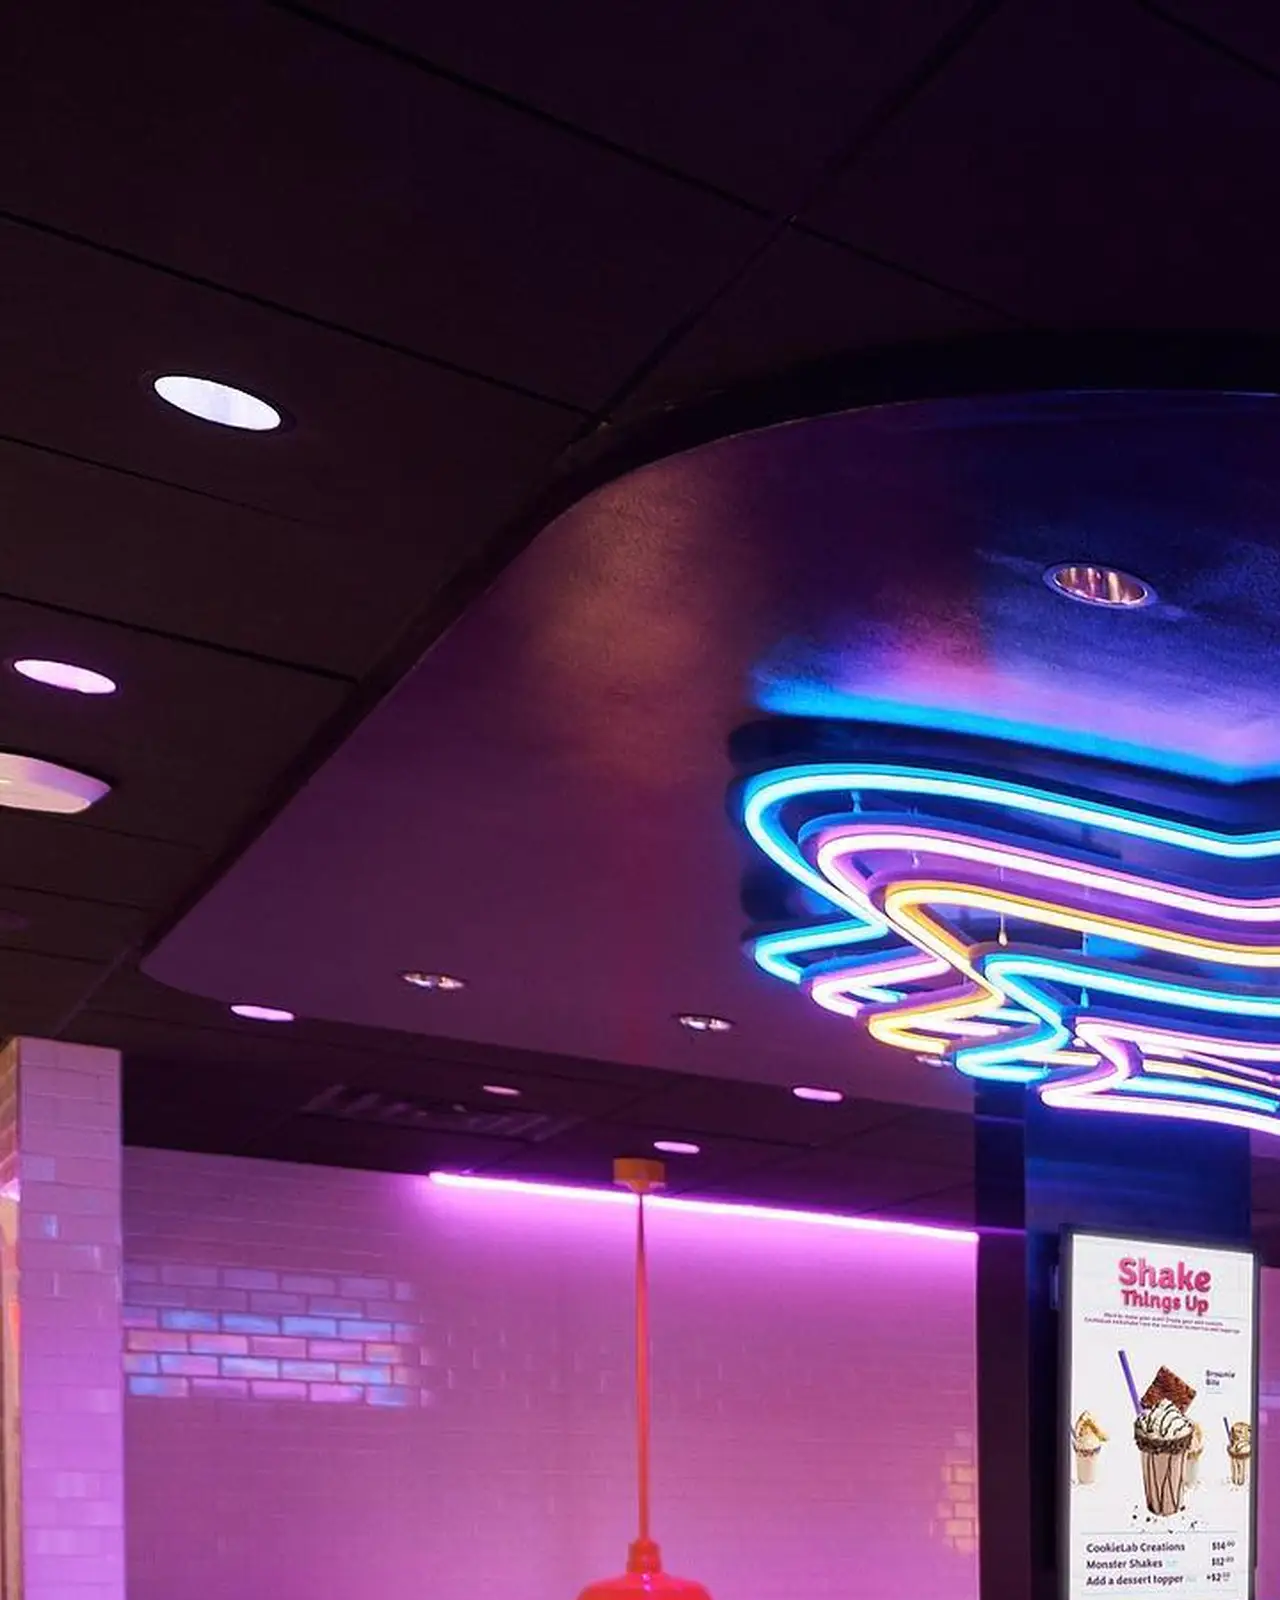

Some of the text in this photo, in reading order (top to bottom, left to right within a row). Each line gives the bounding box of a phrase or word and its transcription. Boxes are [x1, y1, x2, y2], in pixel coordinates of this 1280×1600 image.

[1119, 1256, 1211, 1292] Shake
[1121, 1290, 1209, 1316] Things Up
[1086, 1541, 1185, 1553] CookieLab Creations
[1086, 1559, 1126, 1569] Monster
[1129, 1558, 1163, 1568] Shakes
[1086, 1576, 1106, 1586] Add
[1116, 1575, 1151, 1586] dessert
[1153, 1575, 1184, 1587] topper
